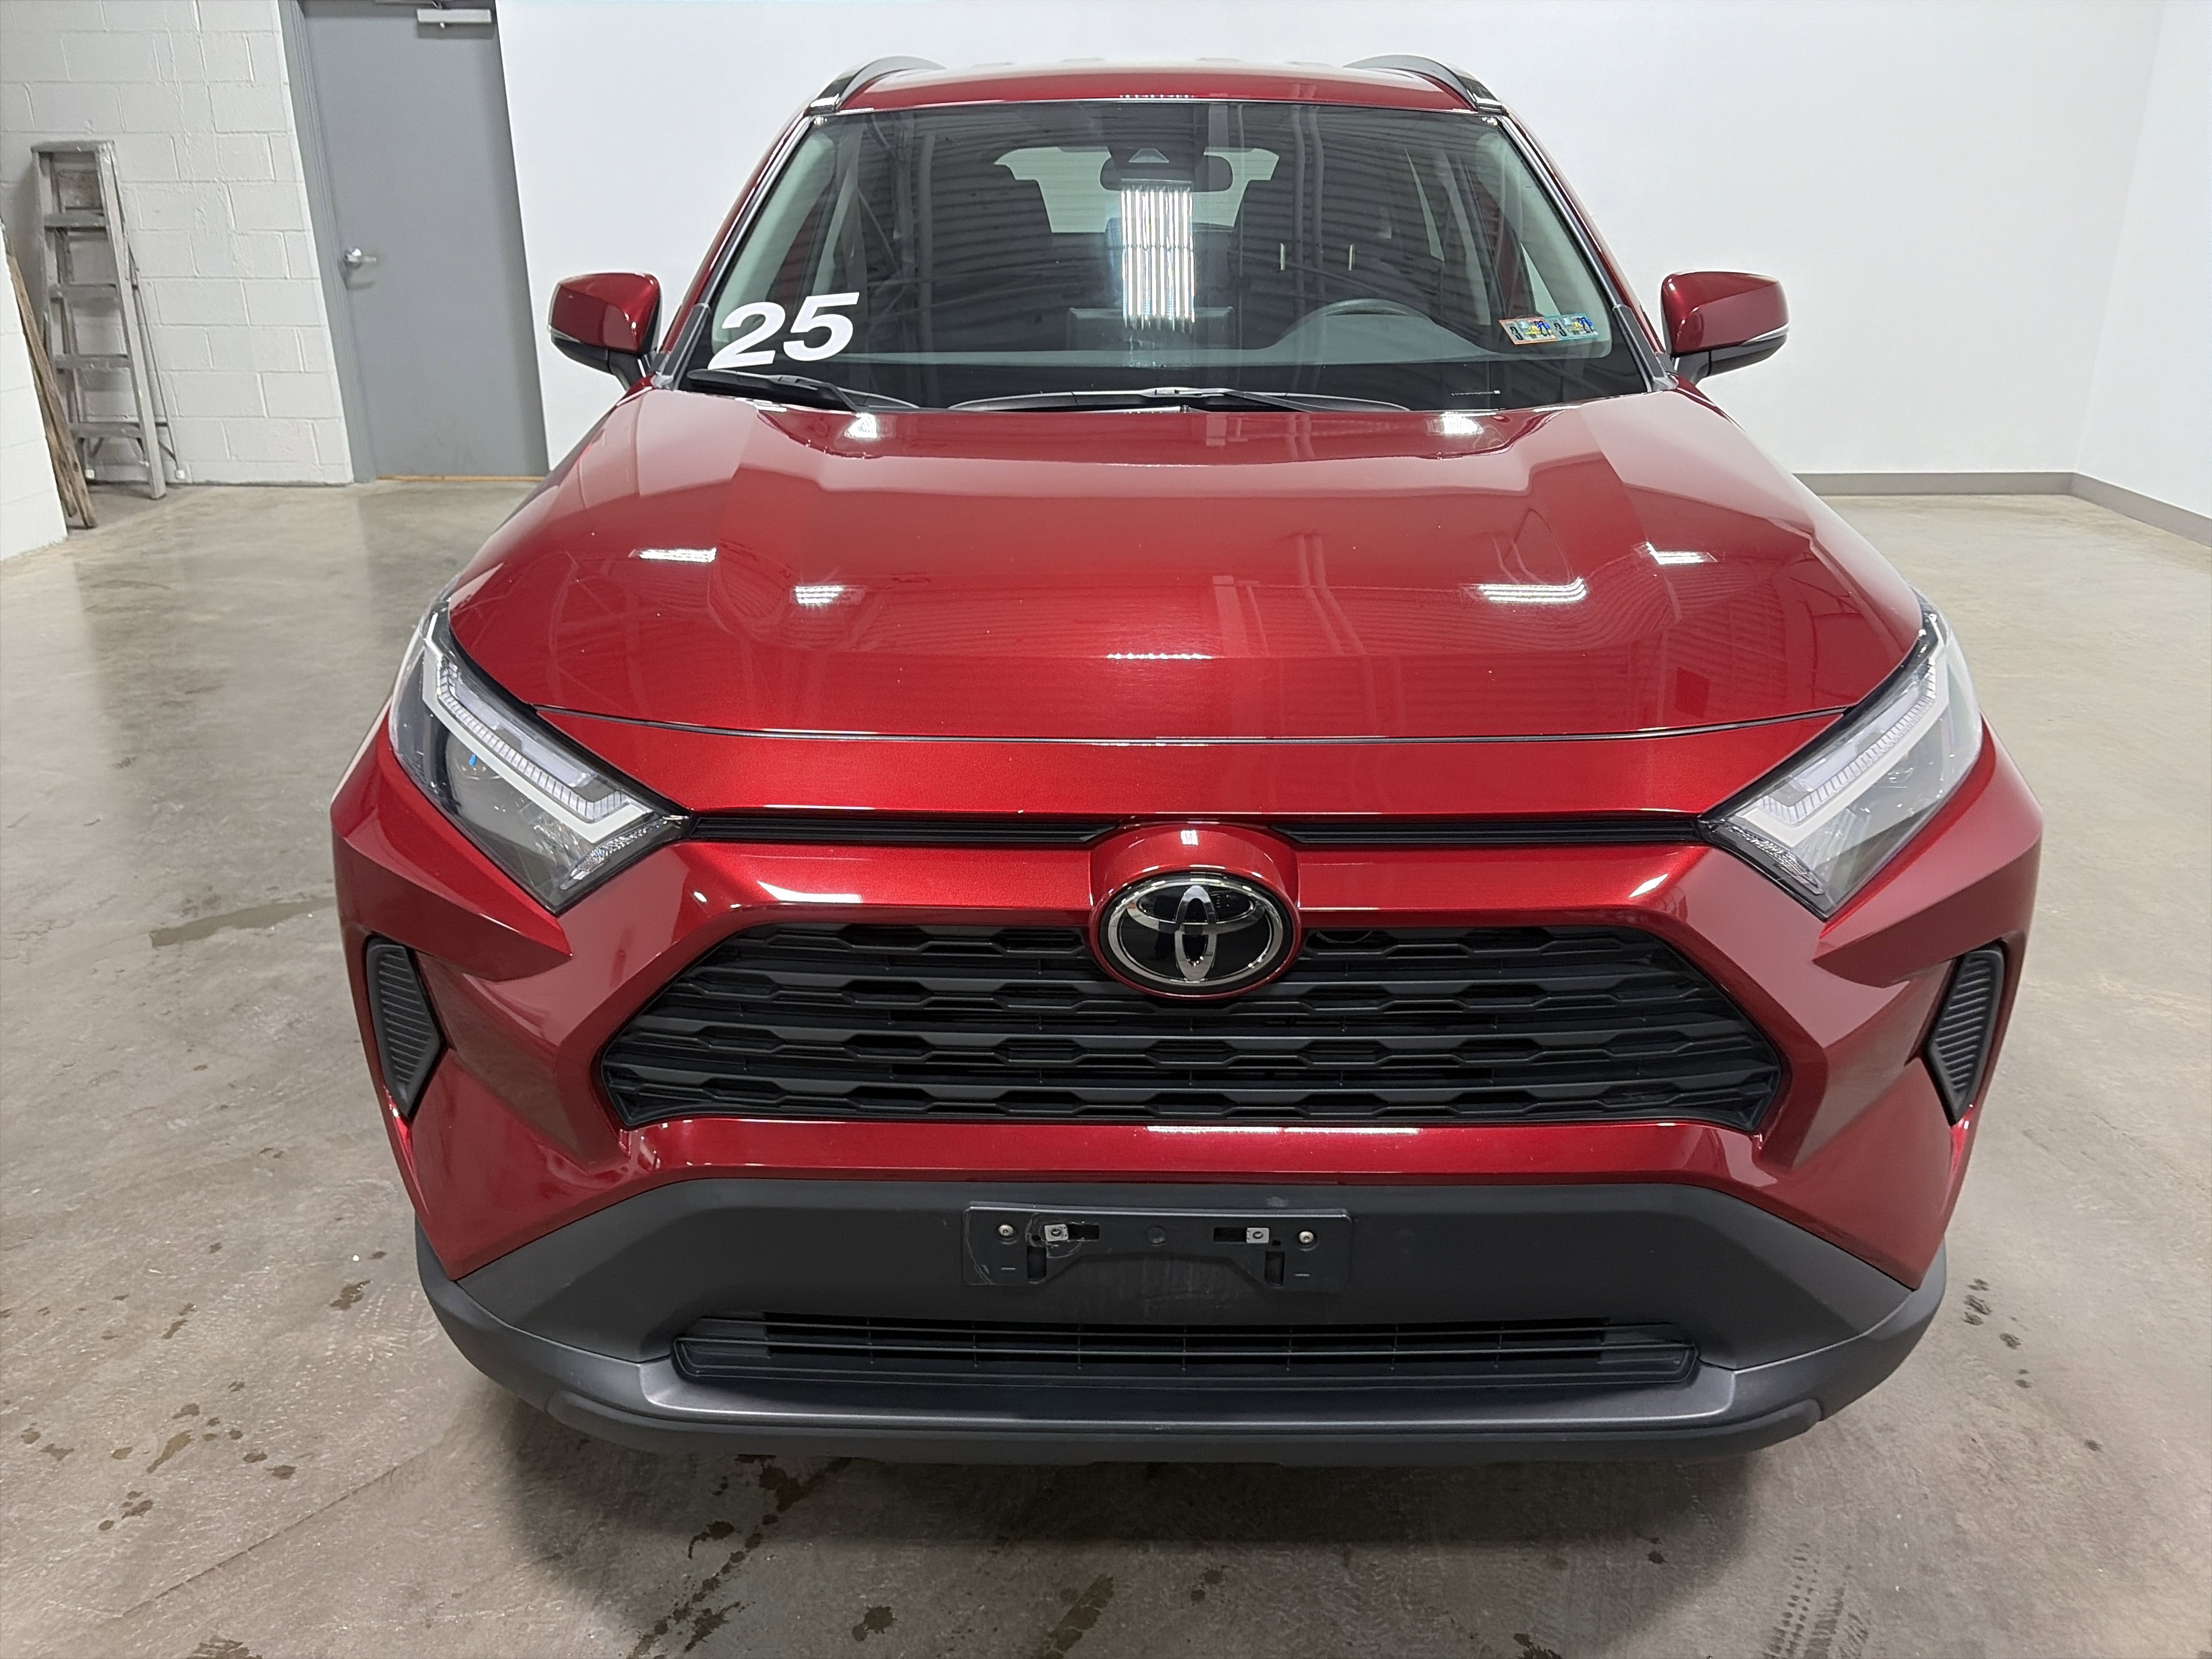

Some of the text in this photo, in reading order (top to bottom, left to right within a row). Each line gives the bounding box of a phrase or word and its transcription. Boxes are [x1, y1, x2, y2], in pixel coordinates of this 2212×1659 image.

[708, 292, 860, 370] 25
[1510, 326, 1523, 340] 3
[1554, 323, 1567, 337] 3
